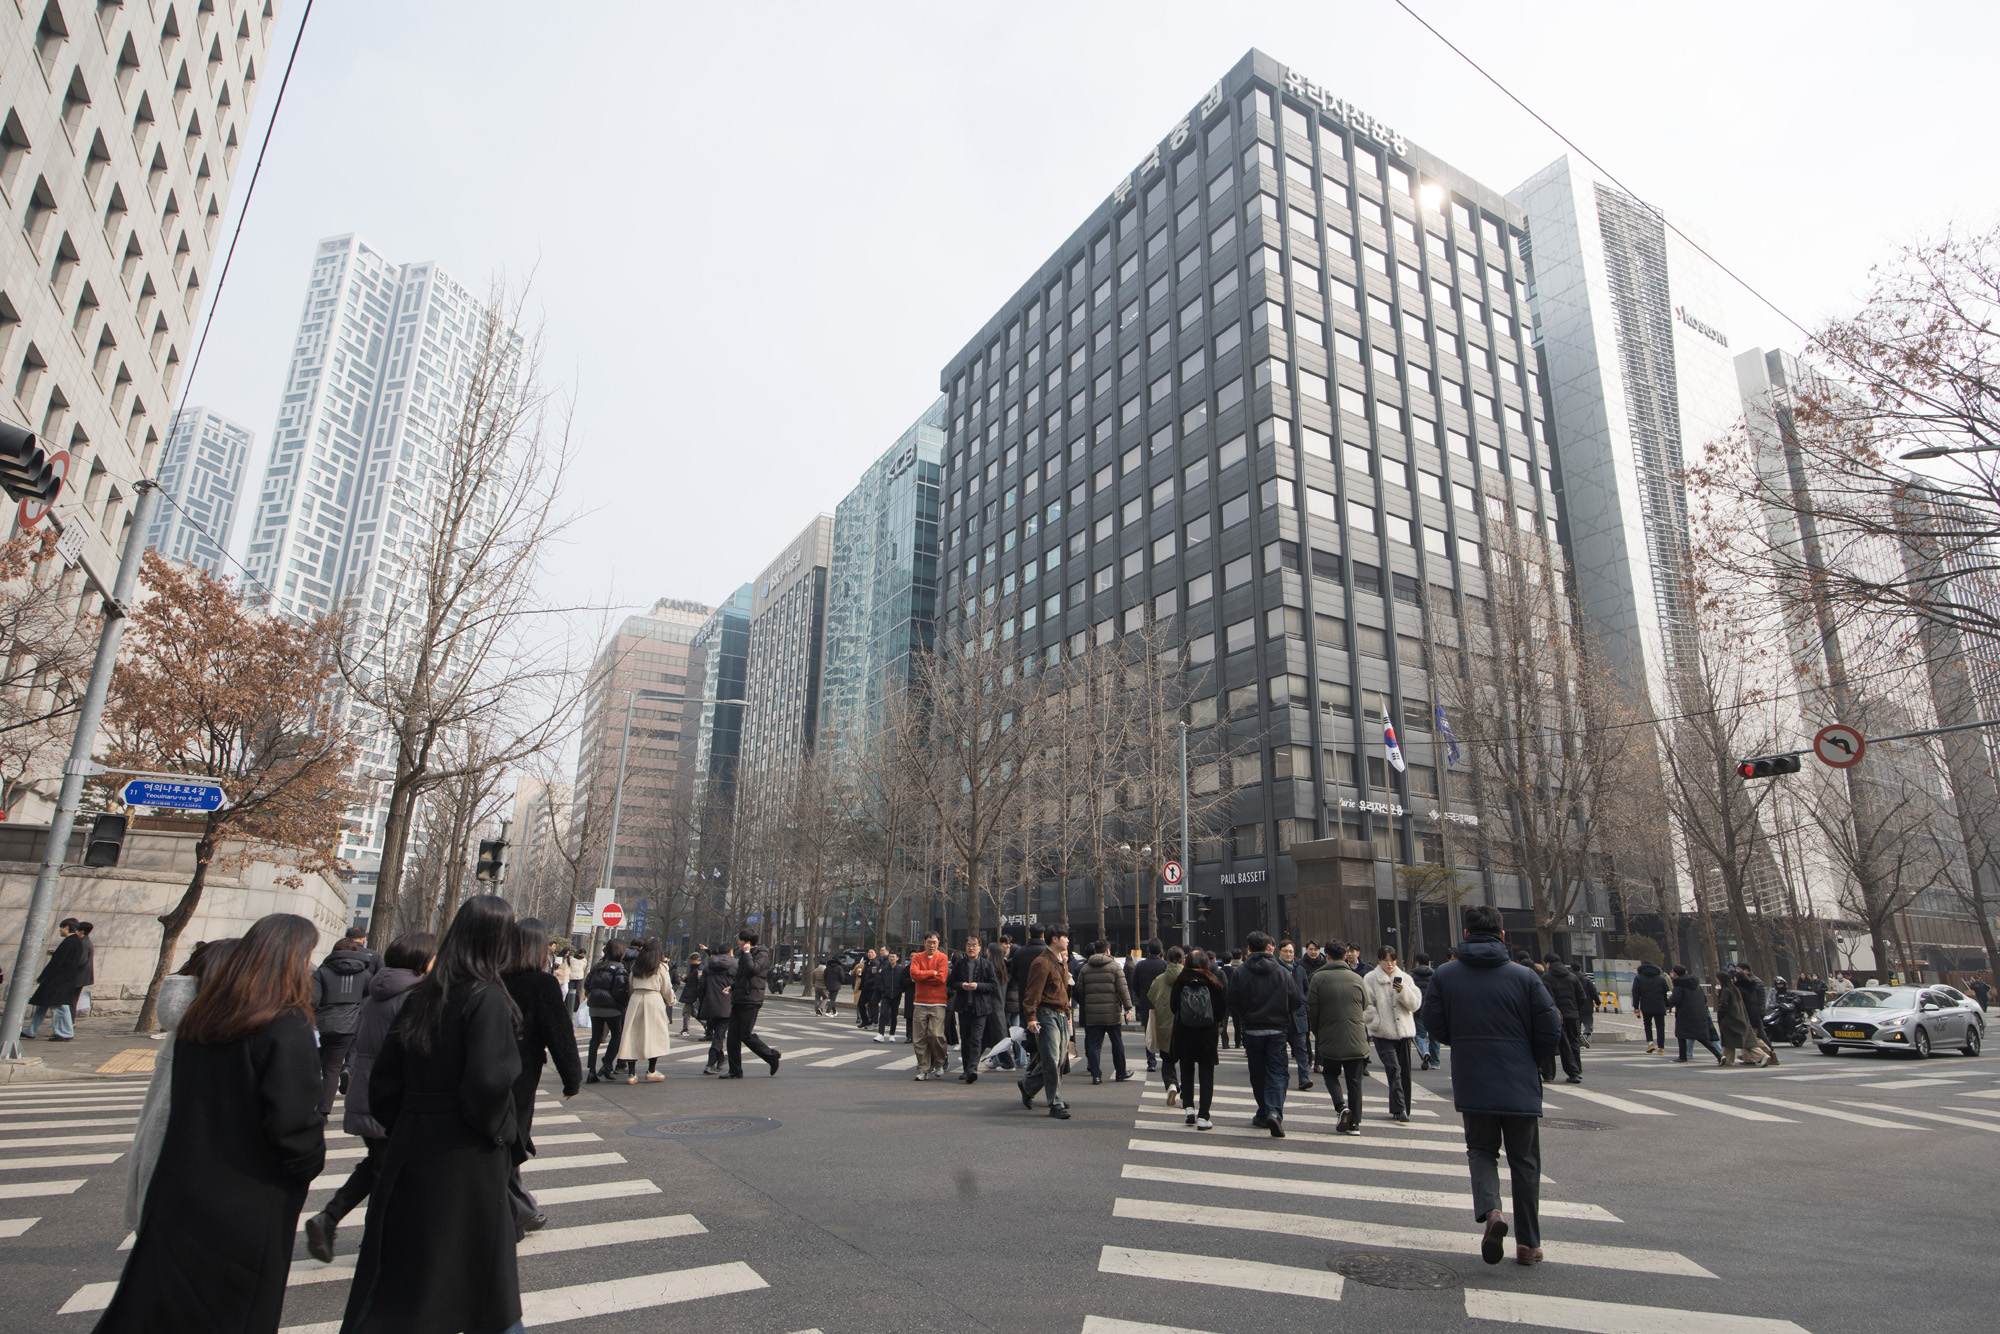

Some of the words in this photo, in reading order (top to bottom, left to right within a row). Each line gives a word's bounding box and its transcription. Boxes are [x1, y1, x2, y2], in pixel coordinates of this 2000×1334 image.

[1283, 66, 1408, 158] 유리자산운용
[1113, 79, 1223, 205] 부국증권
[1680, 305, 1729, 348] koscom
[885, 443, 918, 486] KCB
[656, 597, 710, 616] KANTAR
[143, 783, 207, 796] 여의나루로4길
[145, 792, 187, 801] Yeouinaru-ro
[187, 795, 203, 803] 4-gil
[1220, 873, 1237, 885] PAUL
[1238, 870, 1266, 884] BASSETT
